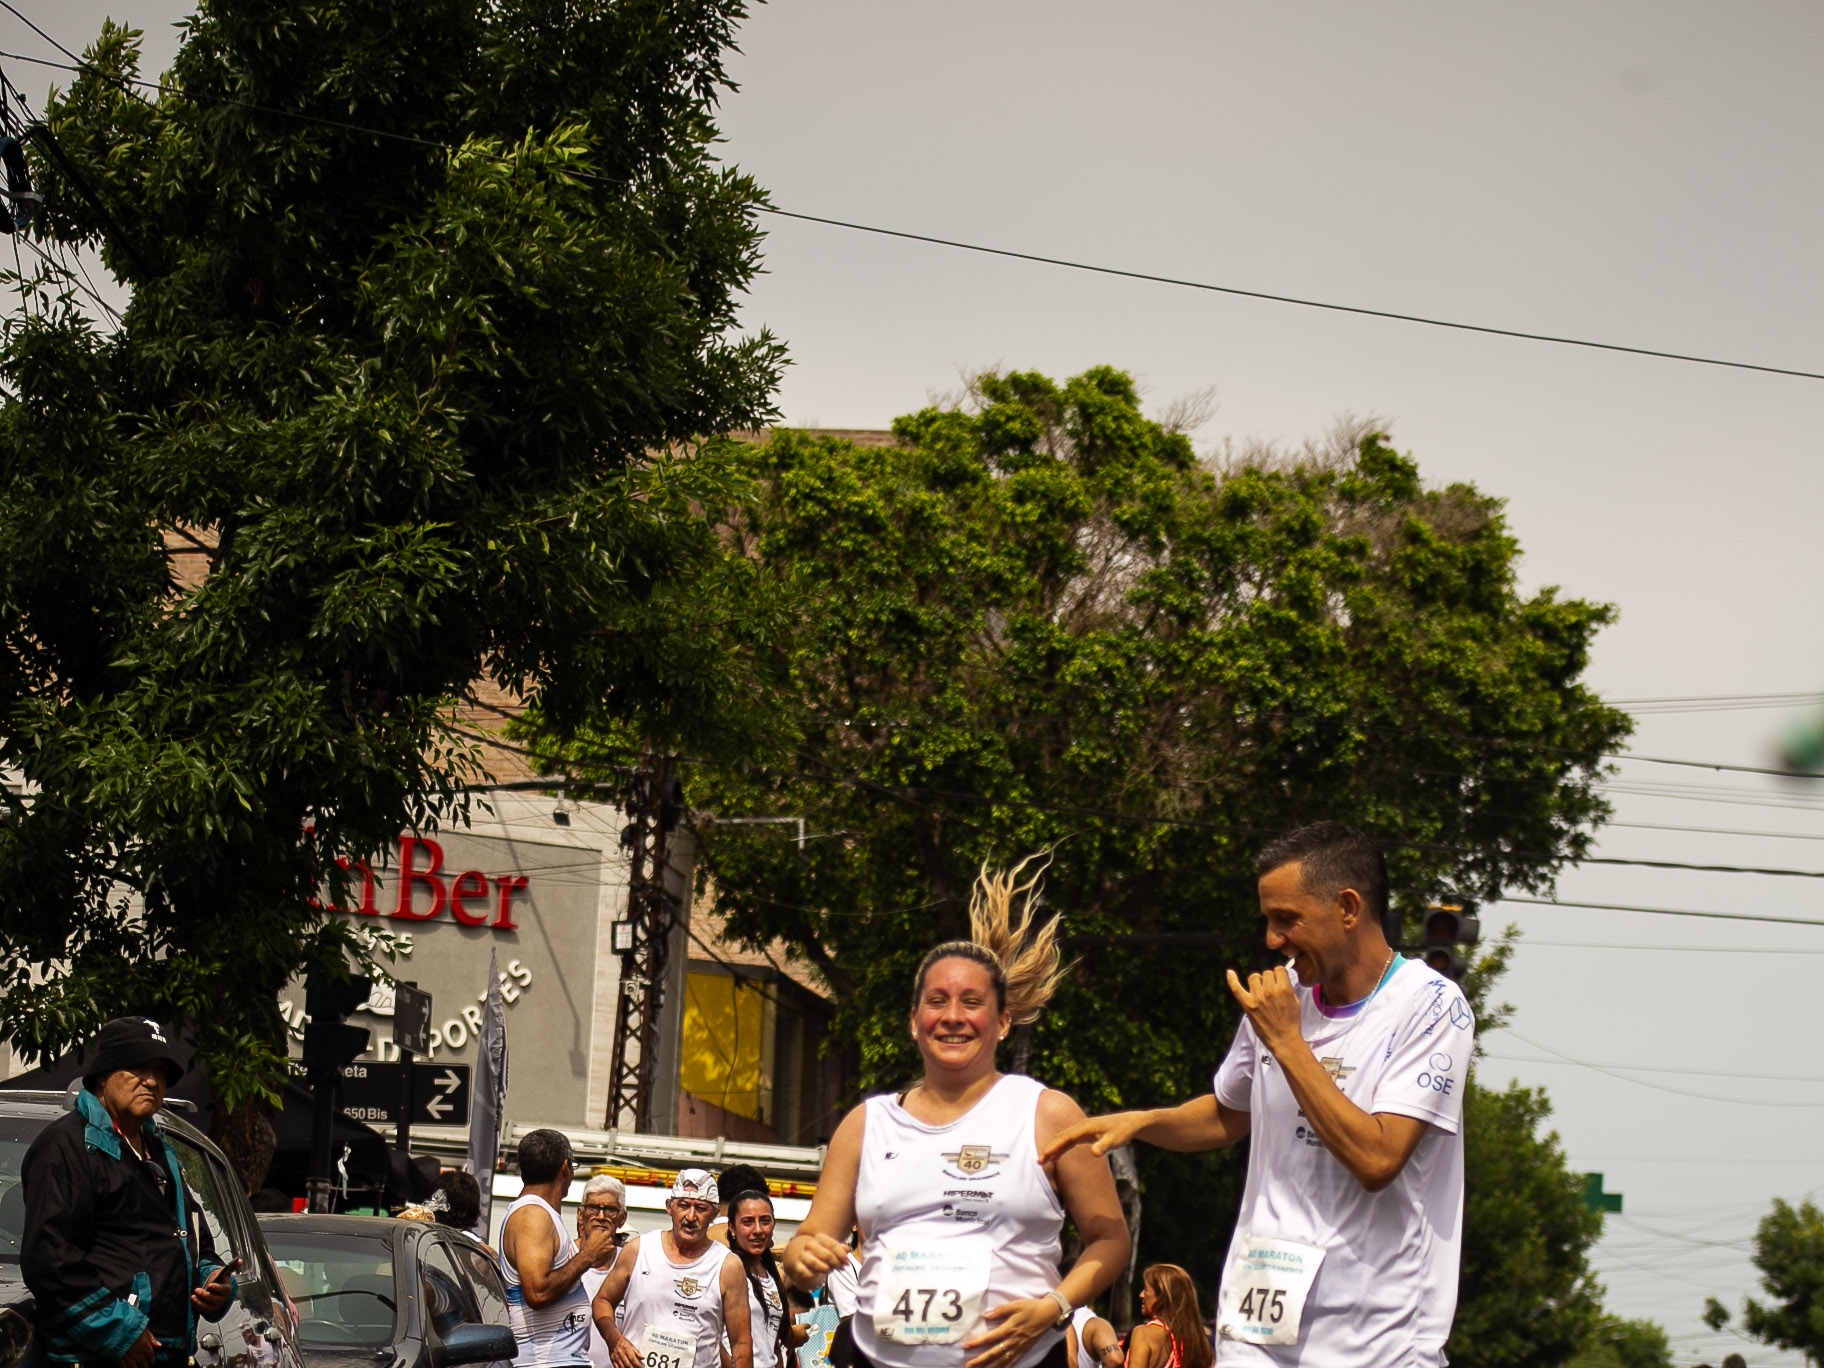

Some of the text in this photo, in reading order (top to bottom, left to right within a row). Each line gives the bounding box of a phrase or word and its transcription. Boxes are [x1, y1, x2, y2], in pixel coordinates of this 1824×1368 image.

[378, 960, 533, 1062] DPORES
[1417, 1072, 1454, 1095] OSE
[367, 1108, 388, 1120] Bis
[963, 1160, 982, 1170] 40
[892, 1289, 963, 1323] 473
[1238, 1287, 1287, 1324] 475
